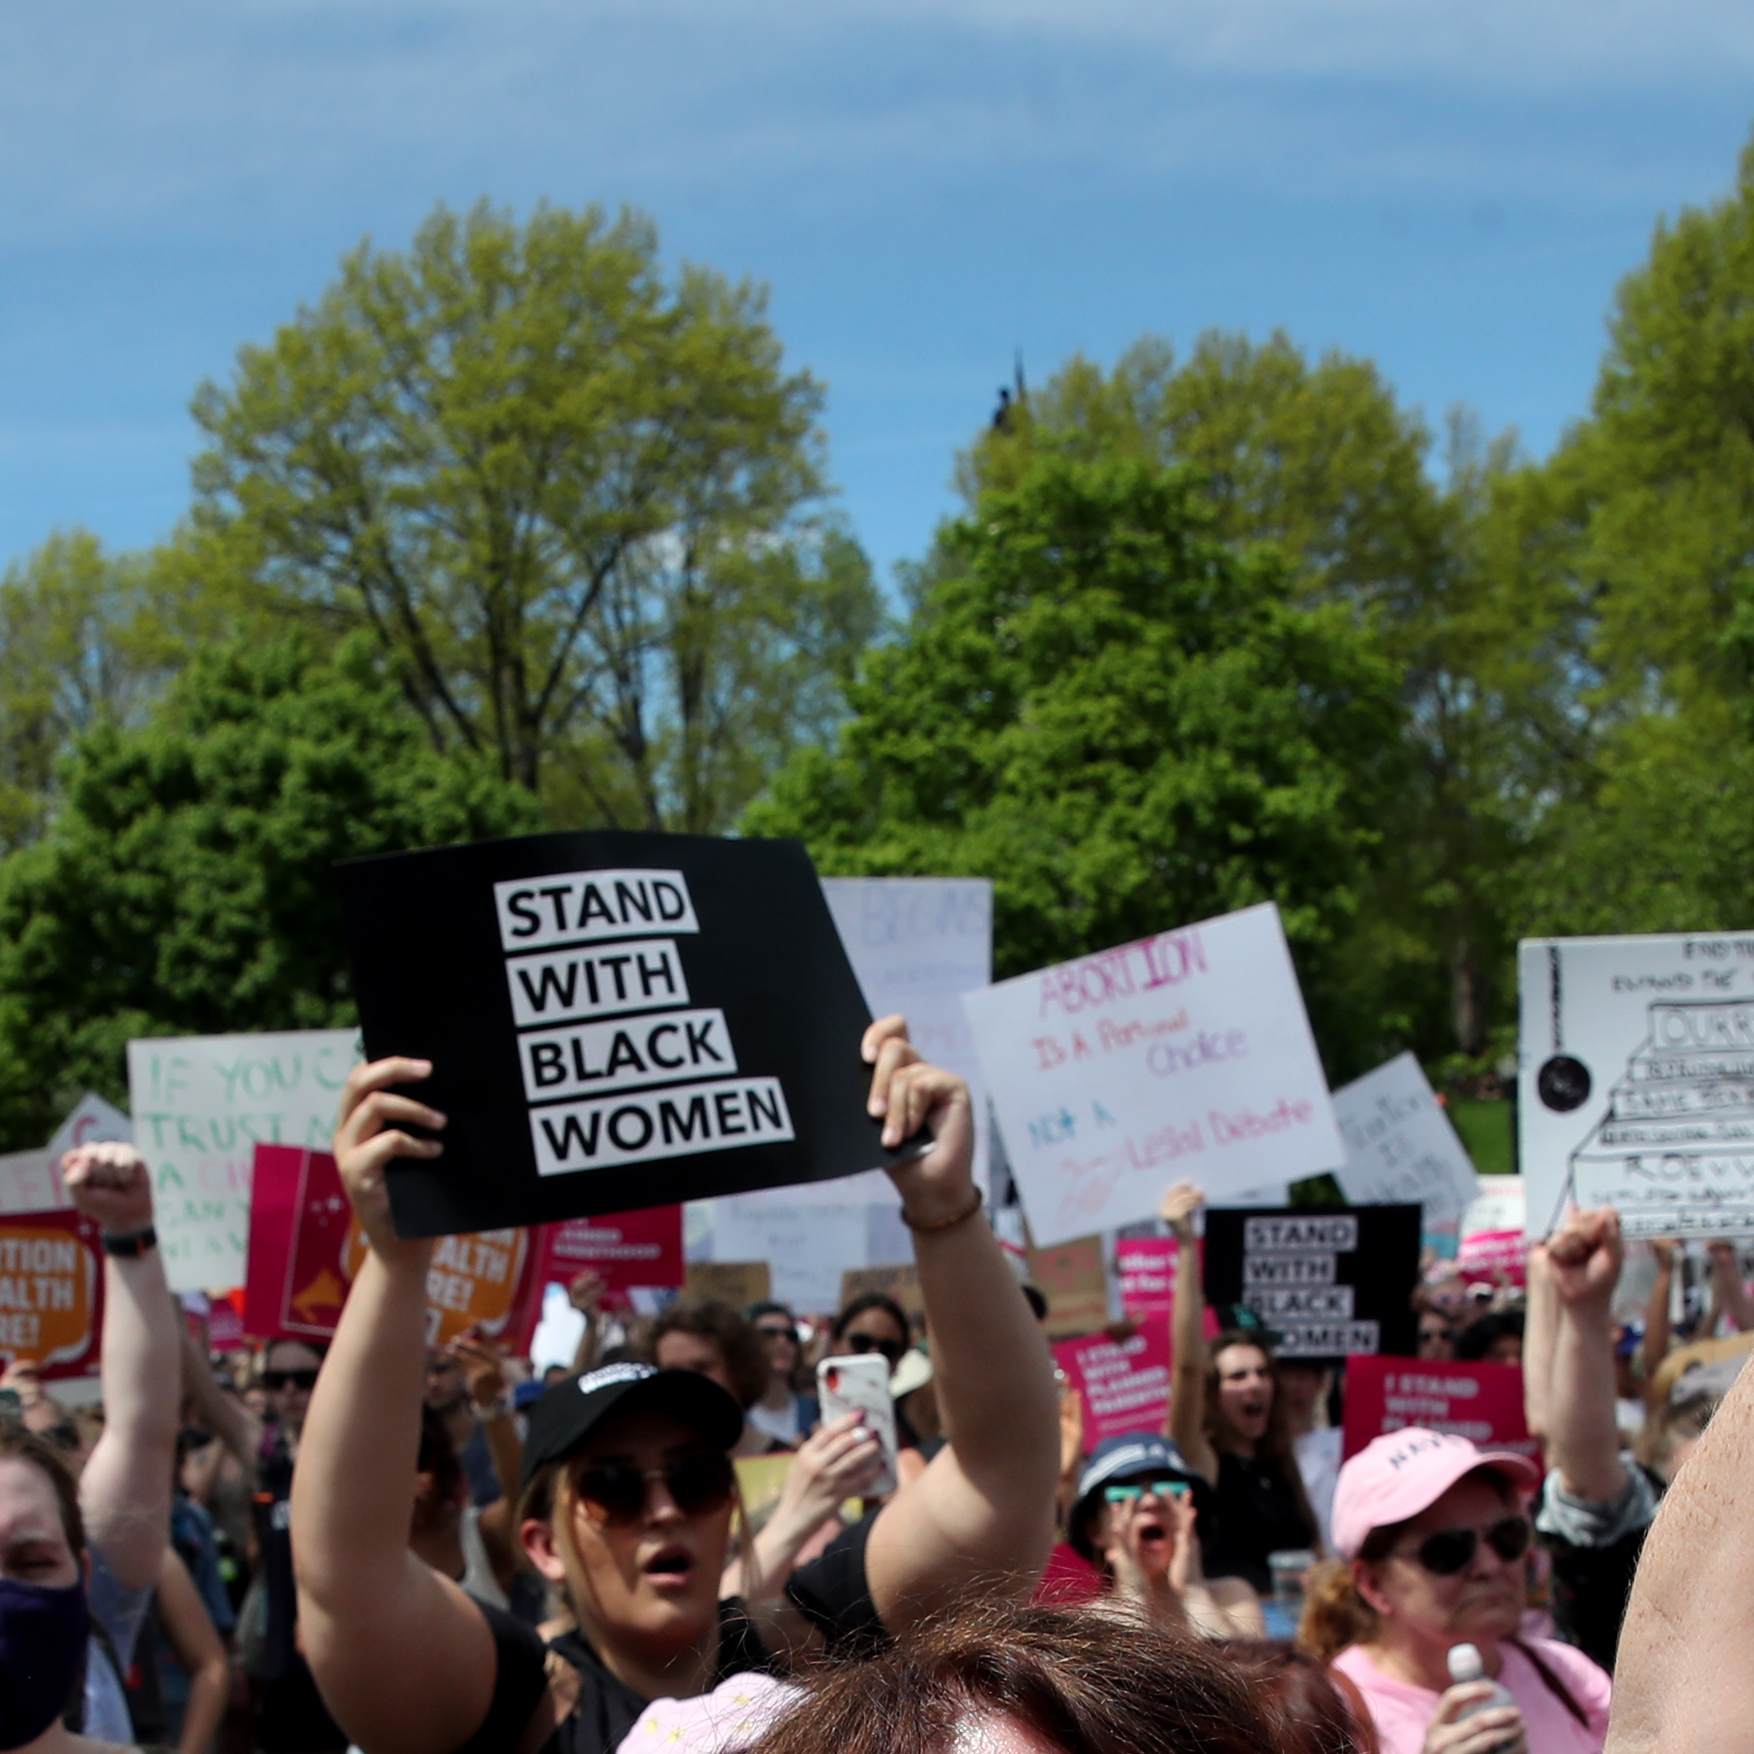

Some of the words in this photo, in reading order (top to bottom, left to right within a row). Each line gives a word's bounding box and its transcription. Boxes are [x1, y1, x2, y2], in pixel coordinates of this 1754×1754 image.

[507, 879, 686, 937] STAND
[516, 951, 677, 1013] WITH
[1039, 929, 1209, 1019] ABORTION
[530, 1019, 724, 1087] BLACK
[1072, 1029, 1091, 1058] A
[1145, 1026, 1247, 1078] Choice
[150, 1055, 189, 1102] IF
[211, 1053, 303, 1101] YOU
[539, 1089, 784, 1162] WOMEN
[434, 1233, 509, 1283] ALTH
[1249, 1222, 1353, 1248] STAND
[1249, 1258, 1332, 1282] WITH
[1281, 1324, 1376, 1351] OMEN
[1399, 1375, 1479, 1398] STAND
